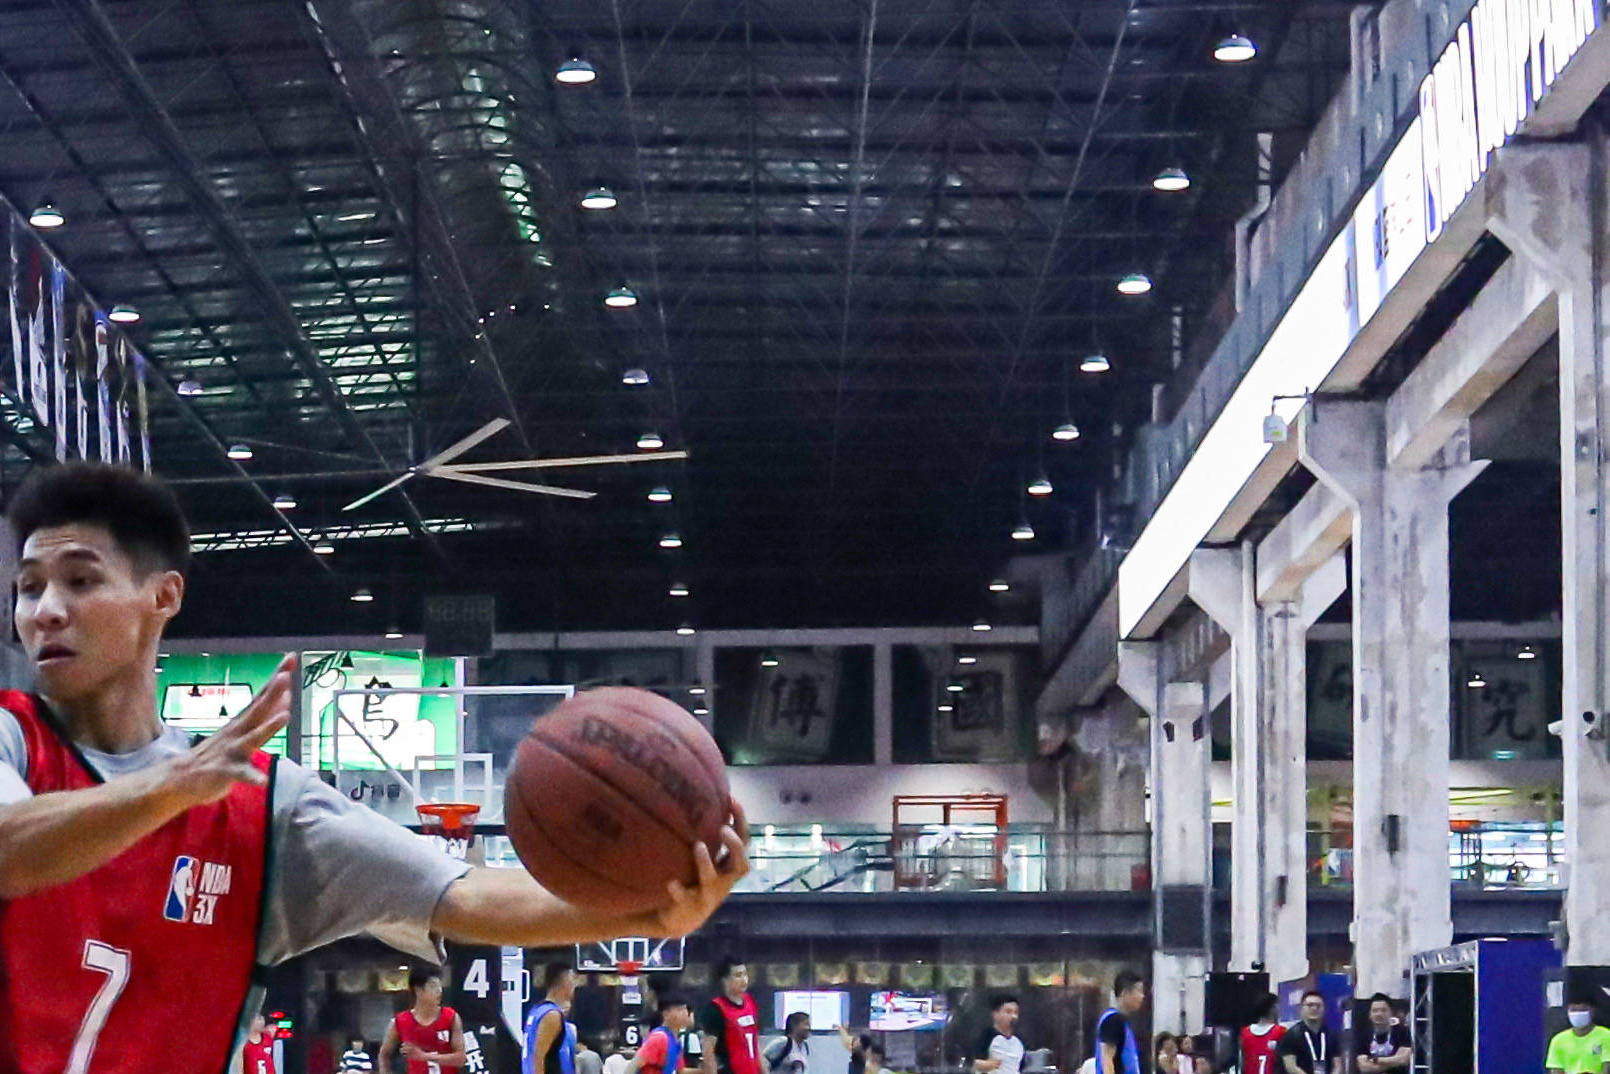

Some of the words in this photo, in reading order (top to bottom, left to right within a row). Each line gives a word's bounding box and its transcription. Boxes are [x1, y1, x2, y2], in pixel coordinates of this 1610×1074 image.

[199, 861, 232, 895] NBA
[192, 894, 218, 925] 3X
[463, 958, 490, 998] 4
[625, 1026, 639, 1045] 6
